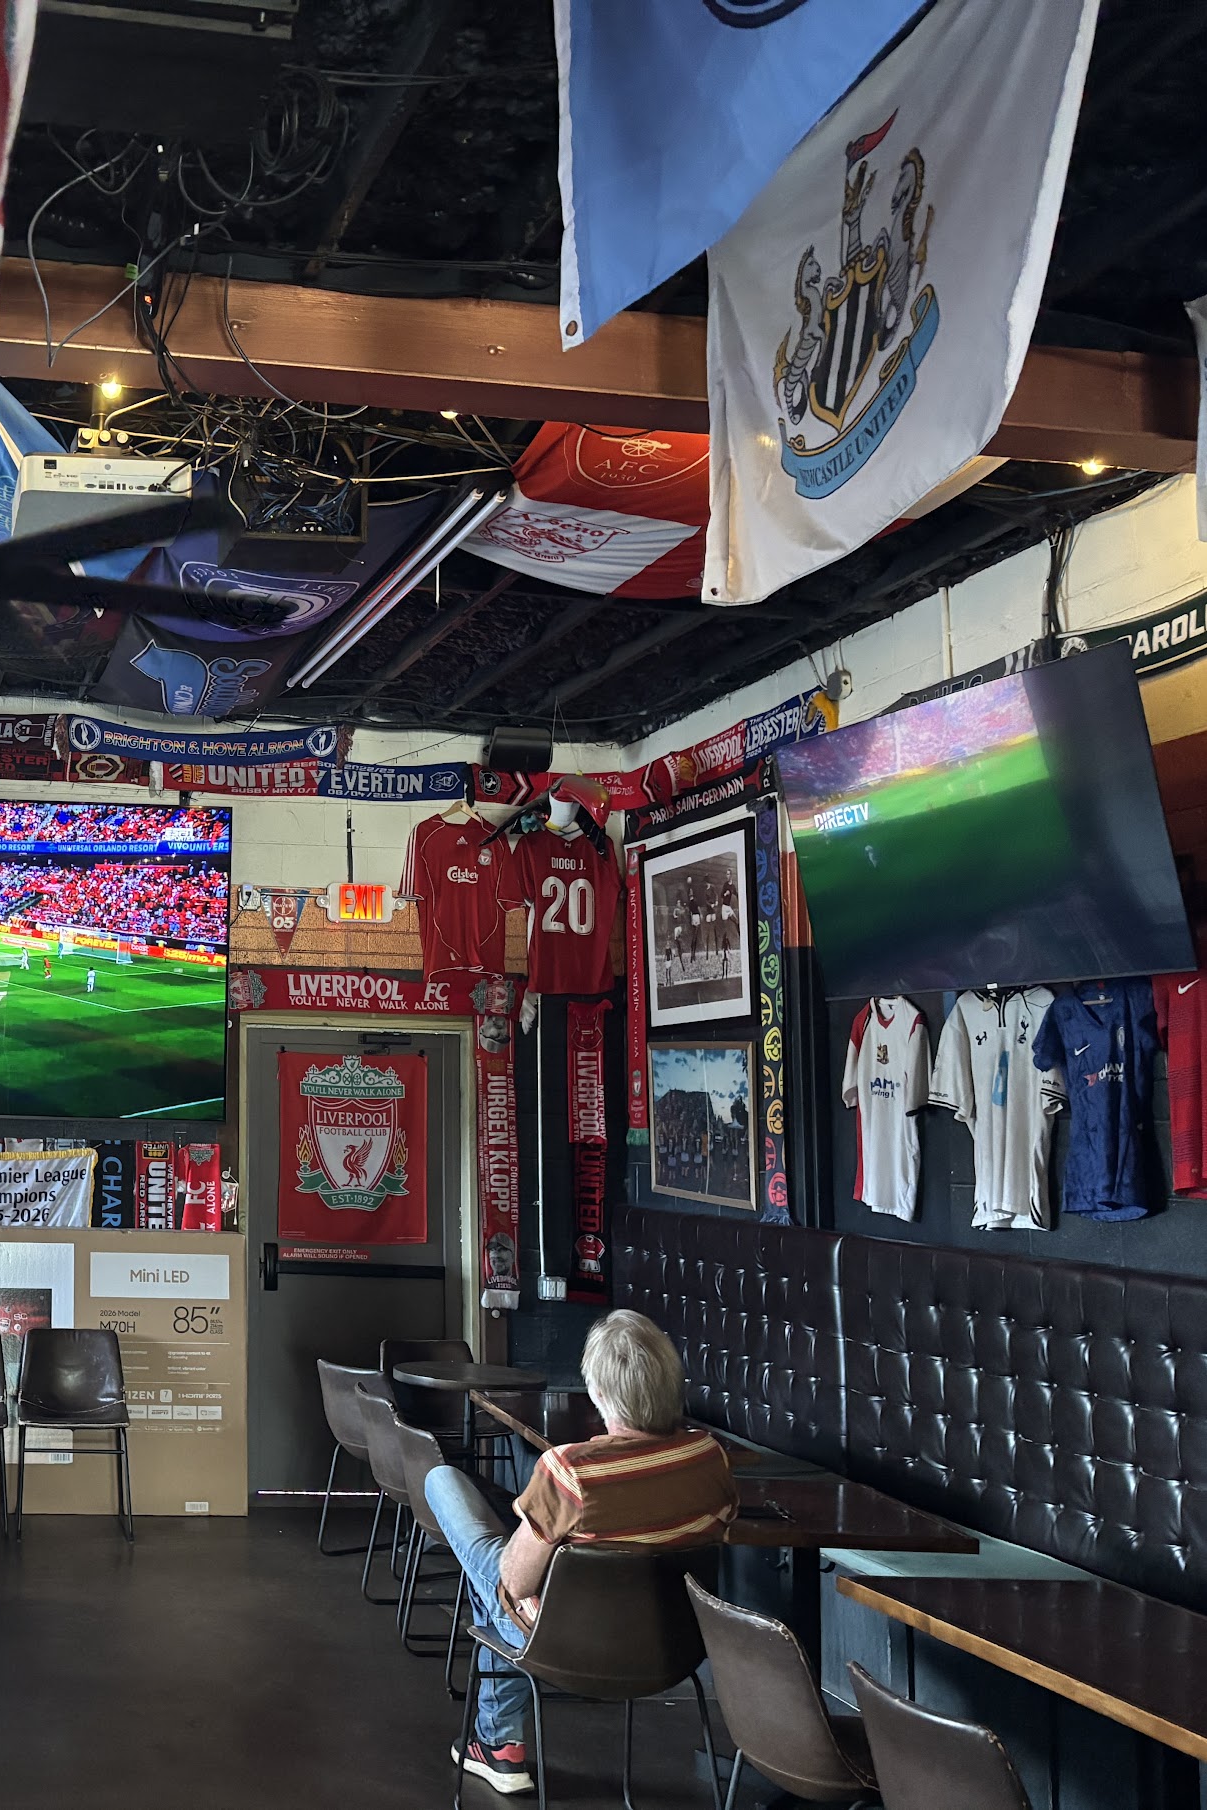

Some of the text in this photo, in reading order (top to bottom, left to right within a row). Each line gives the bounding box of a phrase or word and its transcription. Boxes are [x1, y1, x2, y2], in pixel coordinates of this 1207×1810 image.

[799, 373, 909, 490] NEWCASTLE UNITED
[594, 457, 660, 475] AFC
[1129, 603, 1207, 660] AROLI
[103, 731, 304, 757] BRIGHTON & HOVE ALBION
[696, 732, 743, 774] LIVERPOOL
[746, 706, 798, 752] LEICESTER
[709, 727, 735, 744] MATCH
[209, 764, 424, 794] UNITED EVERTON
[231, 786, 268, 794] BUSBY
[650, 775, 744, 826] PARIS SAINT-GERMAIN
[813, 802, 870, 832] DIRECTV
[5, 843, 36, 852] RESORT
[57, 842, 157, 853] UNIVERSAL ORLANDO RESORT
[167, 841, 190, 851] VIVO
[551, 856, 576, 871] DIOGO
[339, 884, 386, 920] EXIT
[541, 875, 595, 936] 20
[272, 916, 295, 930] 05
[75, 937, 118, 950] FOREVER
[629, 886, 640, 1011] NEVER ALONE
[163, 947, 211, 962] $25/mo.
[287, 973, 451, 1002] LIVERPOOL FC
[289, 995, 450, 1011] YOU'LL NEVER WALK ALONE
[303, 1084, 402, 1097] YOU'LL NEVER WALK ALONE
[316, 1110, 391, 1126] LIVERPOOL
[597, 1084, 606, 1140] MATCHDAY
[319, 1127, 388, 1137] FOOTBALL CLUB
[487, 1072, 511, 1213] JURGEN KLOPP
[577, 1051, 600, 1233] LIVERPOOL UNITED
[35, 1167, 87, 1186] League
[508, 1110, 519, 1224] HE HE CONQUERED!
[147, 1161, 167, 1230] UNITE
[186, 1181, 206, 1205] FC
[206, 1180, 216, 1215] ALONE
[130, 1268, 190, 1284] Mini LED
[99, 1309, 141, 1318] 2026 Model
[99, 1320, 136, 1334] M70H
[125, 1390, 155, 1400] IZEN
